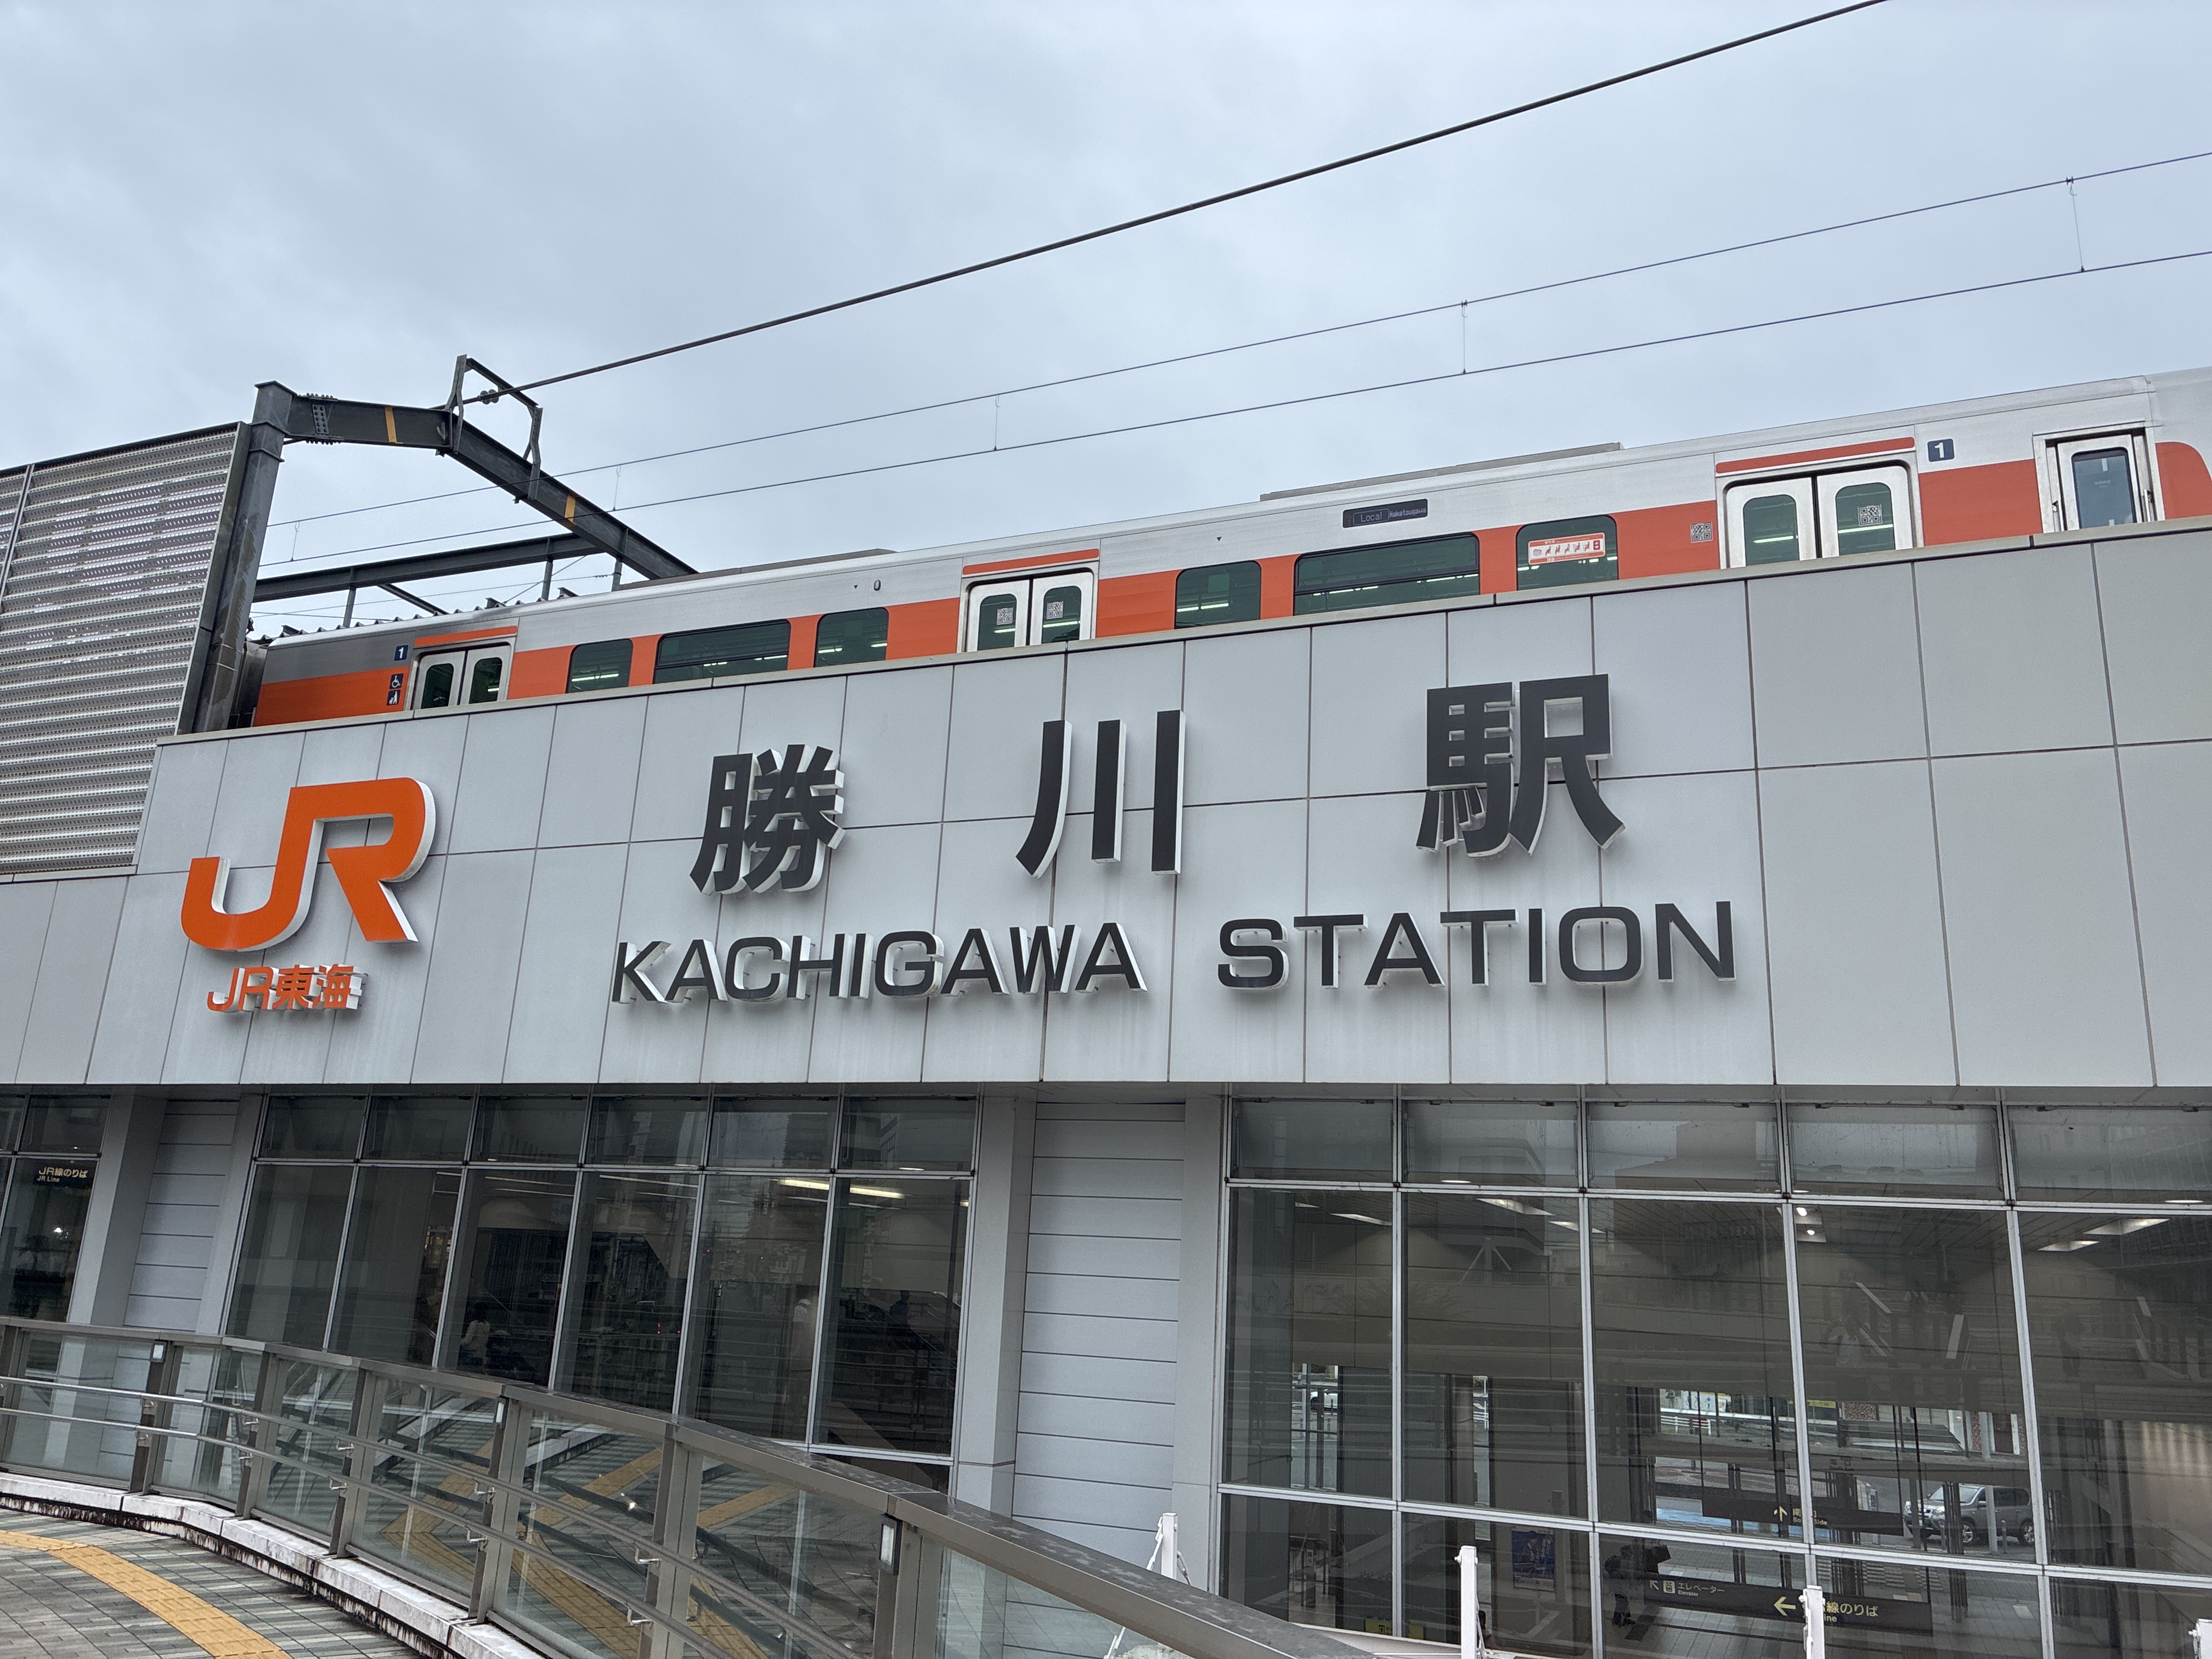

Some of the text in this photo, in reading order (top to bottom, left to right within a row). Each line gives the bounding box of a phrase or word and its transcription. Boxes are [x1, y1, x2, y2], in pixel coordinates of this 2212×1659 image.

[1934, 442, 1945, 459] 1
[1360, 511, 1383, 522] Local
[398, 647, 404, 659] 1
[690, 674, 1625, 896] 勝川駅
[181, 777, 436, 951] JR
[612, 901, 1736, 1003] KACHIGAWA STATION
[207, 963, 369, 1012] JR東海
[38, 1166, 89, 1178] JR線のりば
[1678, 1582, 1725, 1594] エレベーター
